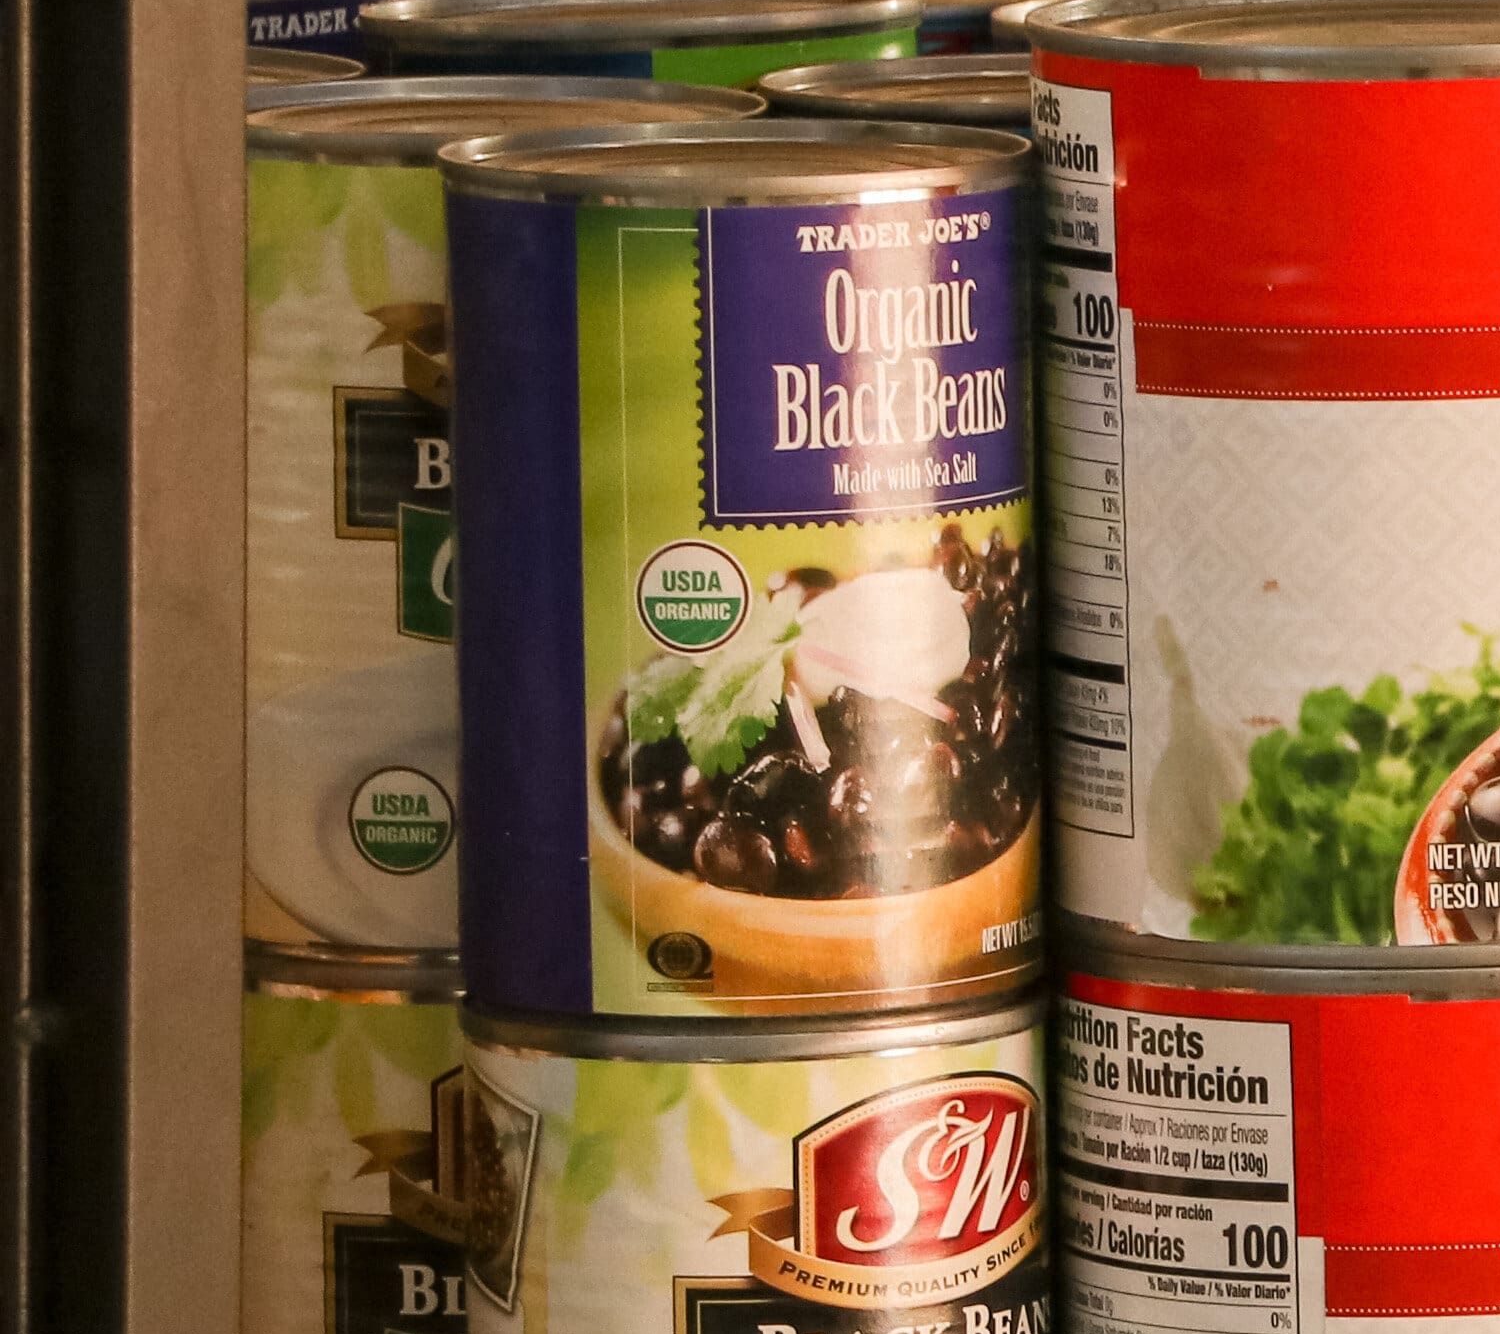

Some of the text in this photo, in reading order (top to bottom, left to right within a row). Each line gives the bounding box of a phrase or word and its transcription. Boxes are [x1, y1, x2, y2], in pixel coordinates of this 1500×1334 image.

[252, 9, 351, 41] TRADER
[797, 222, 912, 254] TRADER
[825, 262, 978, 363] Organic
[1074, 292, 1114, 340] 100
[773, 359, 1005, 452] Black Beans
[833, 454, 978, 498] Made with Sea Salt
[662, 569, 722, 594] USDA
[654, 602, 731, 623] ORGANIC
[372, 794, 430, 819] USDA
[364, 824, 437, 845] ORGANIC
[1428, 843, 1464, 870] NET
[982, 925, 1001, 953] NET
[1127, 1017, 1204, 1059] Facts
[1094, 1052, 1268, 1104] de Nutrición
[1167, 1117, 1268, 1145] Raciones por Envase
[1202, 1150, 1268, 1177] taza (130g)
[1108, 1219, 1288, 1268] Calorías 100
[778, 1232, 1026, 1296] PREMIUM QUALITY SINCE
[1226, 1285, 1251, 1299] Valor
[1270, 1312, 1292, 1330] 0%
